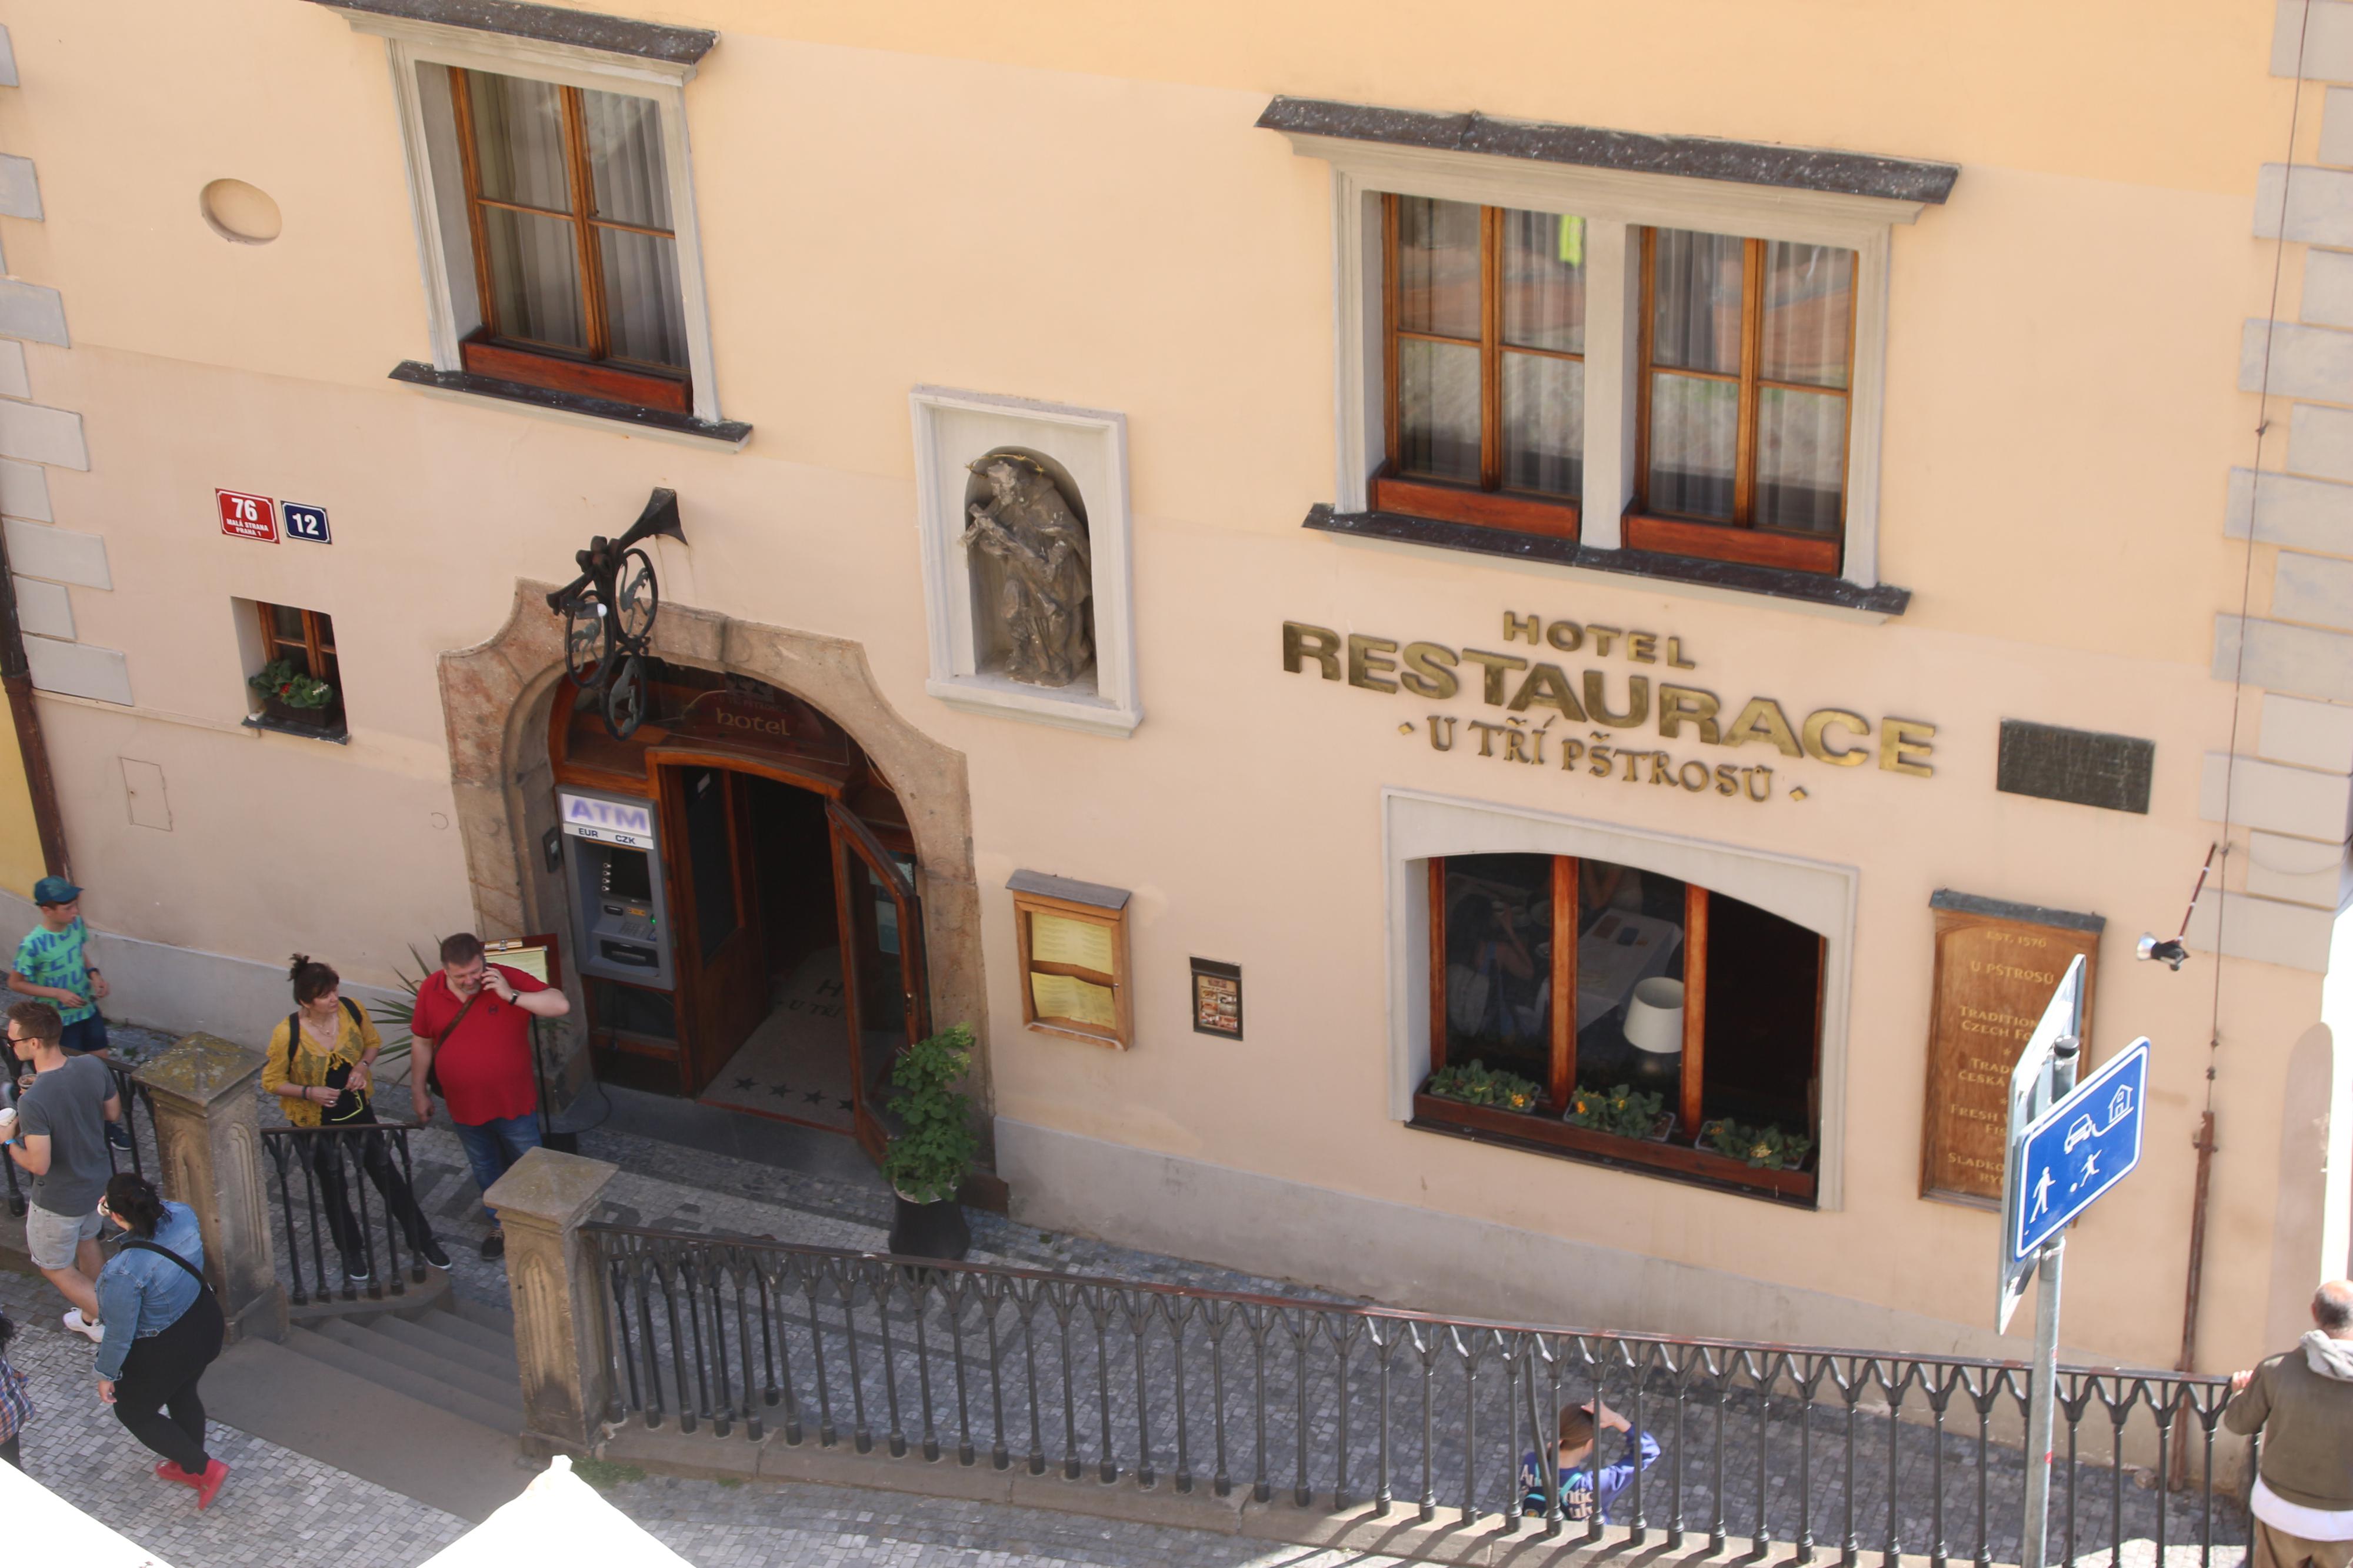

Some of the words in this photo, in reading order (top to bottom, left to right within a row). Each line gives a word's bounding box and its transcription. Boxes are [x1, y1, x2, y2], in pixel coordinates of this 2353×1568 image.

[231, 498, 258, 521] 76
[226, 518, 243, 527] MALÁ
[245, 522, 269, 532] STRANA
[236, 526, 256, 536] PRAHA
[292, 513, 319, 535] 12
[1504, 610, 1695, 670] HOTEL
[1283, 620, 1937, 779] RESTAURACE
[716, 707, 791, 736] hotel
[1427, 715, 1457, 752] U
[1468, 715, 1555, 765] TŘÍ
[1561, 730, 1774, 802] PŠTROSŮ
[571, 799, 646, 831] ATM
[578, 828, 599, 838] EUR
[615, 834, 636, 845] CZK
[1971, 960, 1981, 972] U
[1959, 1005, 2038, 1028] TRADITION
[1962, 1020, 2009, 1037] CZECH
[2015, 1029, 2032, 1041] FO
[1950, 1103, 1998, 1122] FRESH
[1985, 1124, 2007, 1136] FIS
[1948, 1152, 2005, 1172] SLADKO
